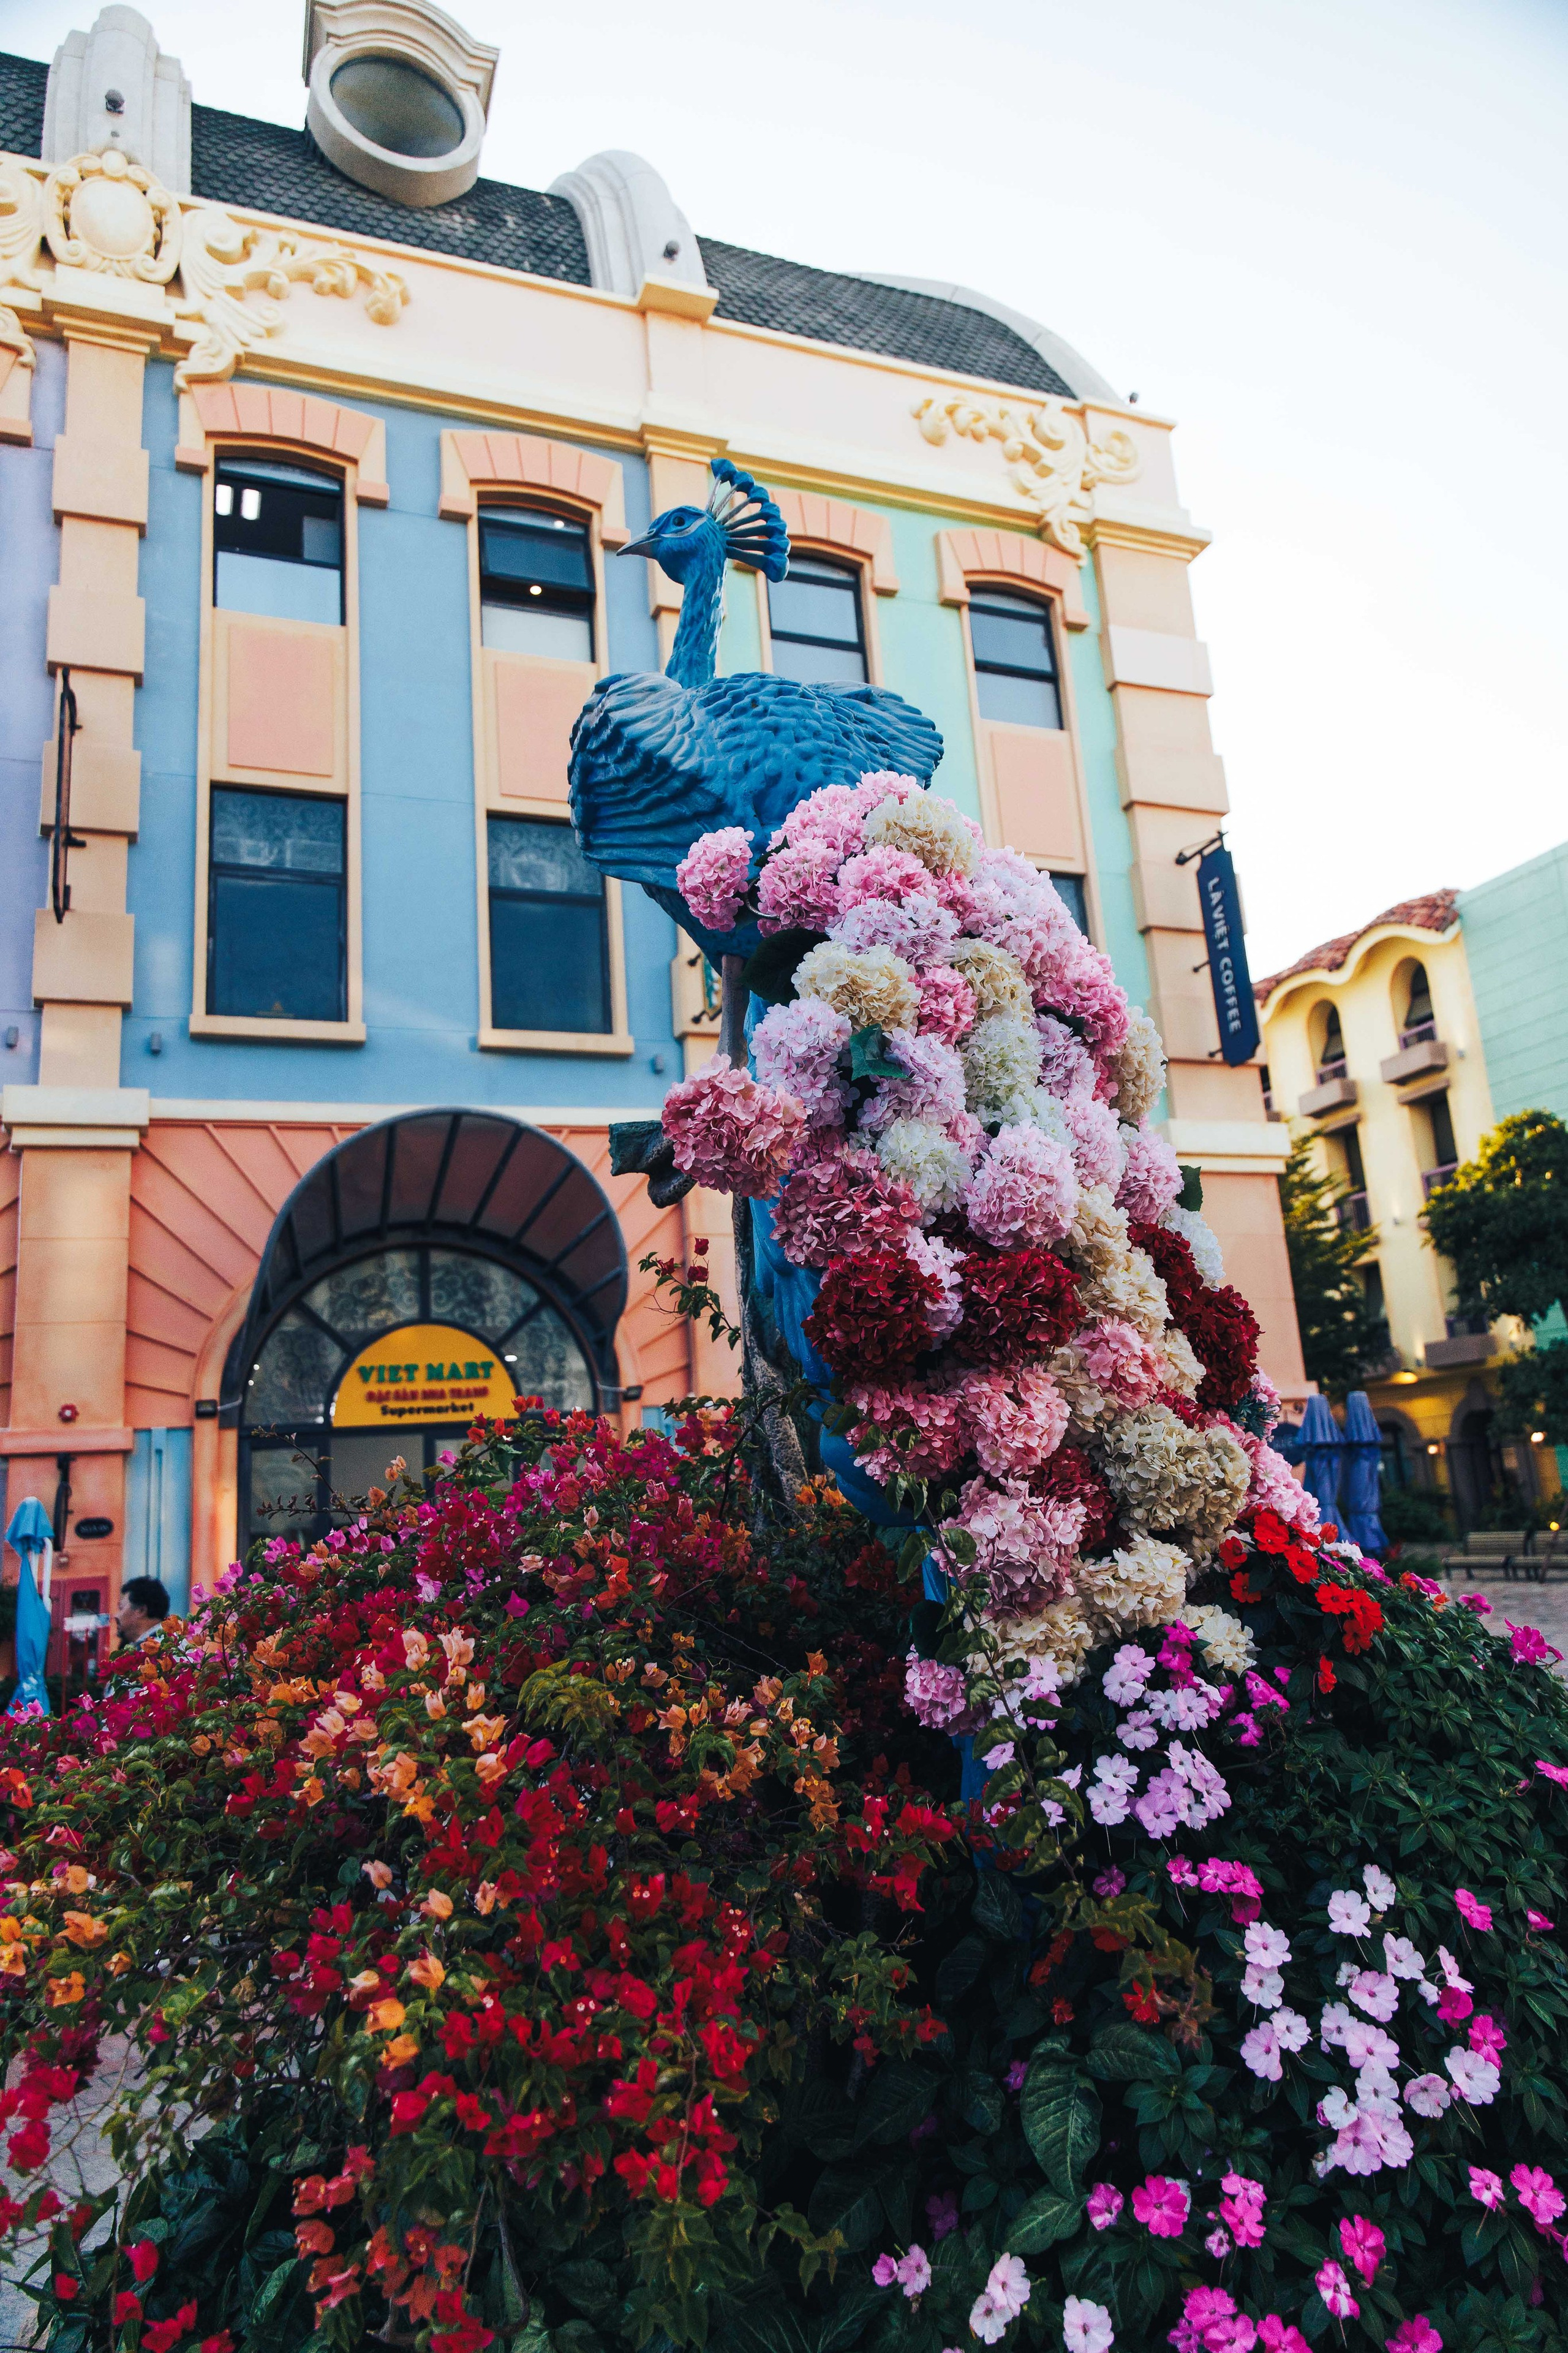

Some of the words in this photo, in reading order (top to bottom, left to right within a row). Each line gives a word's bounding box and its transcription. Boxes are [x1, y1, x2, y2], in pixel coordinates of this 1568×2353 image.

[1219, 956, 1242, 1033] COFFEE
[358, 1363, 419, 1383] VIET
[426, 1361, 494, 1381] MART
[381, 1402, 473, 1417] Supermarket
